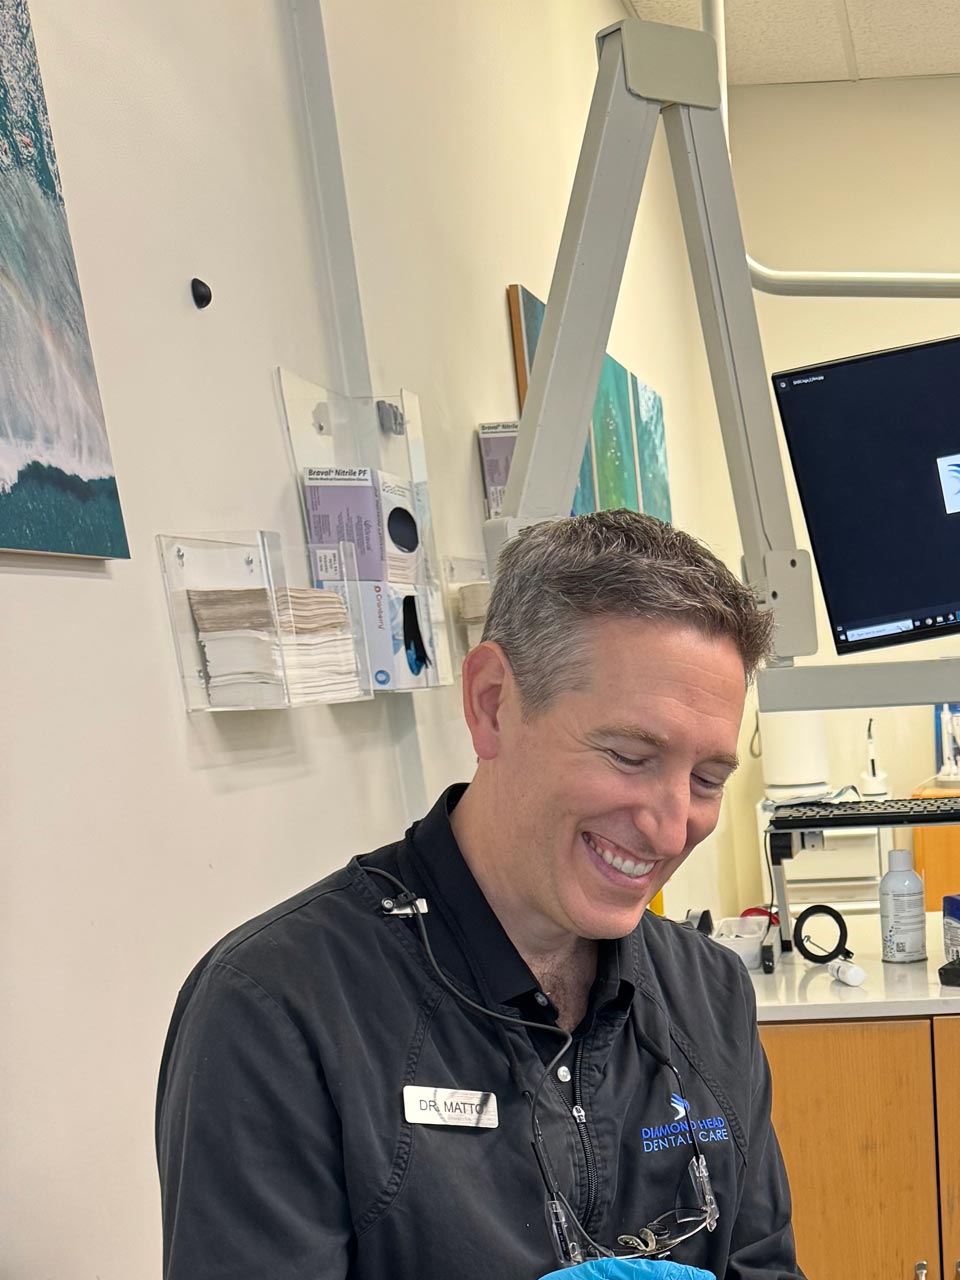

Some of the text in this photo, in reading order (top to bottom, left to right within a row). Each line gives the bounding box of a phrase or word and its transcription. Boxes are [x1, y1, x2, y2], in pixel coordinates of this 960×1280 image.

[335, 469, 357, 477] Nitrile
[358, 469, 368, 477] PF
[641, 1117, 725, 1139] DIAMOND HEAD
[643, 1129, 729, 1152] DENTAL CARE
